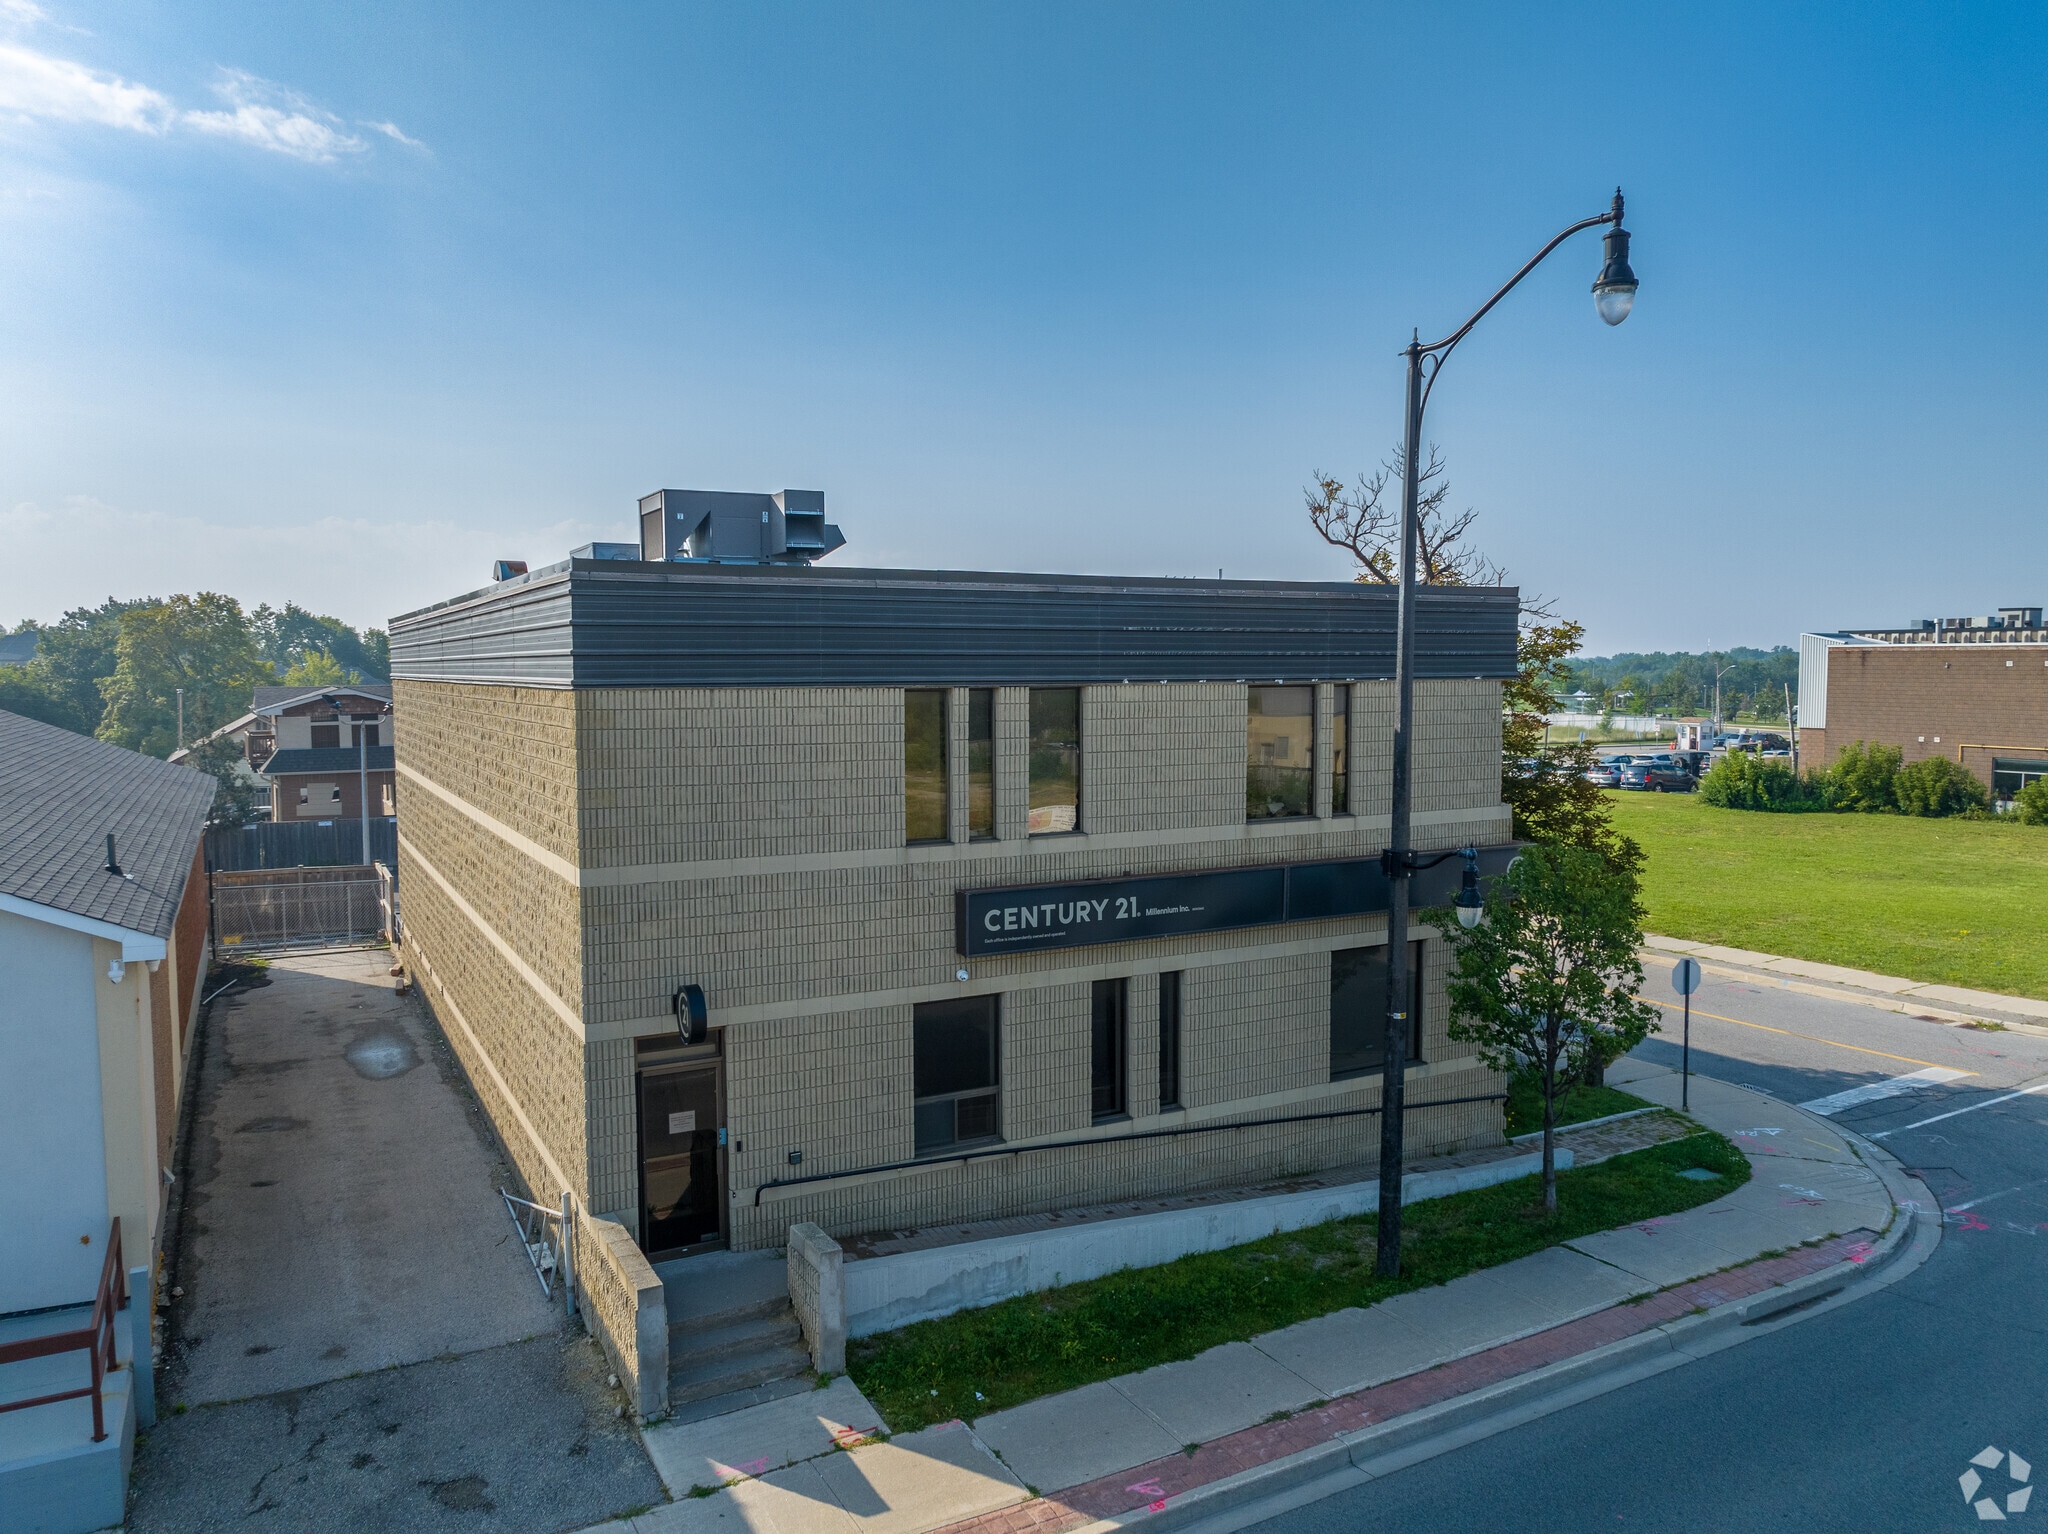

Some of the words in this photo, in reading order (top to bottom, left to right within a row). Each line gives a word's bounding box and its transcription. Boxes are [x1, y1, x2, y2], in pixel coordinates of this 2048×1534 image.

[984, 898, 1110, 932] CENTURY
[1145, 906, 1179, 916] Millennium
[1179, 905, 1190, 913] Inc.
